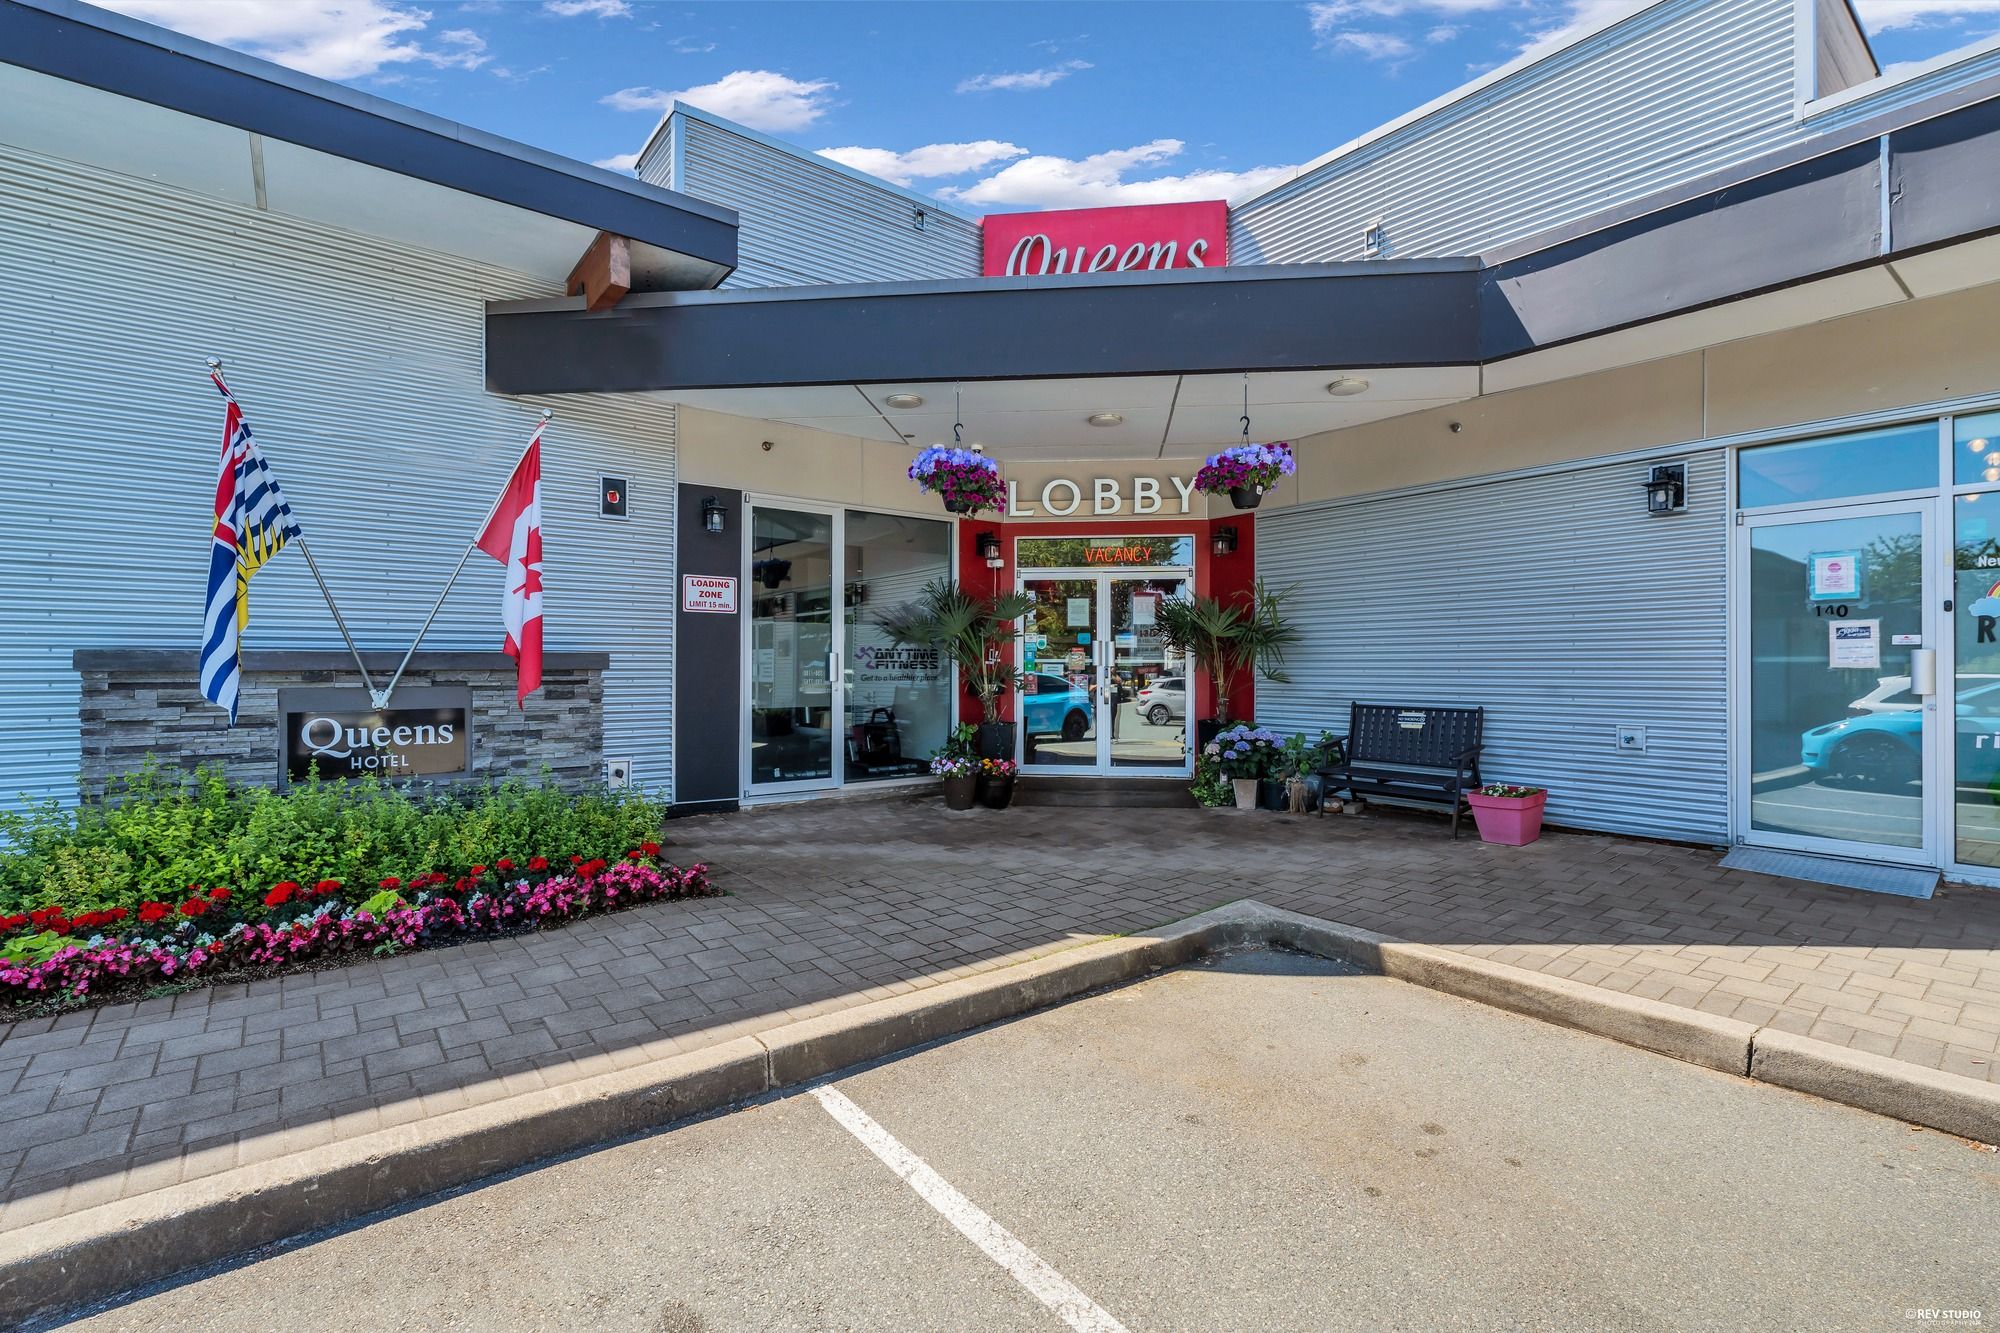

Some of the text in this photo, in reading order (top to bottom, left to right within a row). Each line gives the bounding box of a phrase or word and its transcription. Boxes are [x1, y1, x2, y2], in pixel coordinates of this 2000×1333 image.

[1005, 233, 1208, 276] Queens
[1008, 476, 1197, 517] LOBBY
[1085, 545, 1152, 563] VACANCY
[691, 579, 730, 589] LOADING
[699, 590, 723, 599] ZONE
[689, 600, 707, 608] LIMIT
[708, 601, 717, 609] 15
[1815, 604, 1849, 618] 140
[874, 647, 938, 660] ANYTIME
[874, 660, 938, 670] FITNESS
[861, 673, 874, 682] Get
[875, 674, 883, 682] to
[889, 673, 919, 682] healthier
[301, 717, 454, 759] Queens
[351, 754, 409, 770] HOTEL
